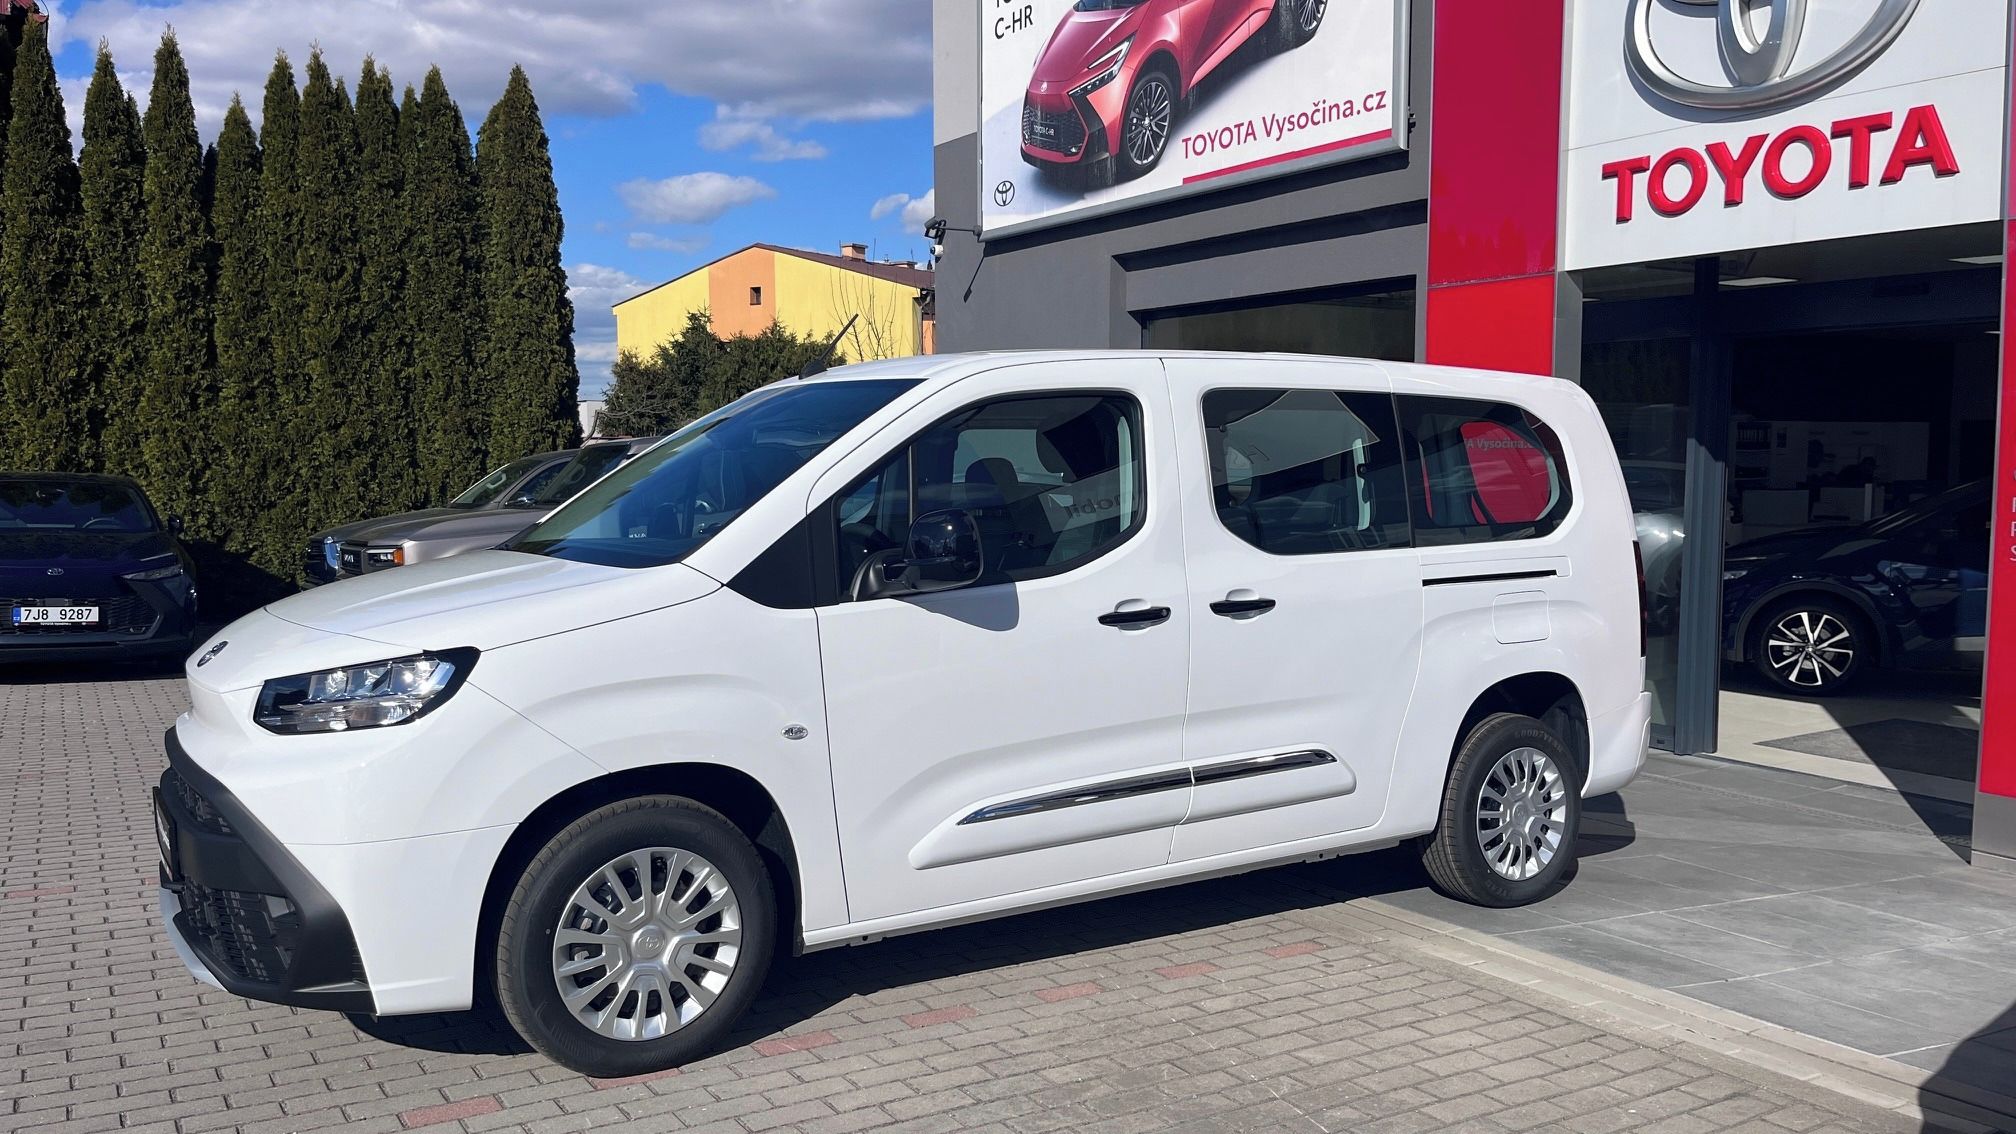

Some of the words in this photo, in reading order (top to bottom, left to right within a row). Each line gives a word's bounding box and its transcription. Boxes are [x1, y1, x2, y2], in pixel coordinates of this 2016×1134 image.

[994, 4, 1033, 40] C-HR
[1181, 119, 1257, 160] TOYOTA
[1261, 90, 1387, 142] Vysočina.cz
[1602, 104, 1960, 224] TOYOTA
[24, 608, 49, 621] 7J8
[59, 608, 92, 621] 9287
